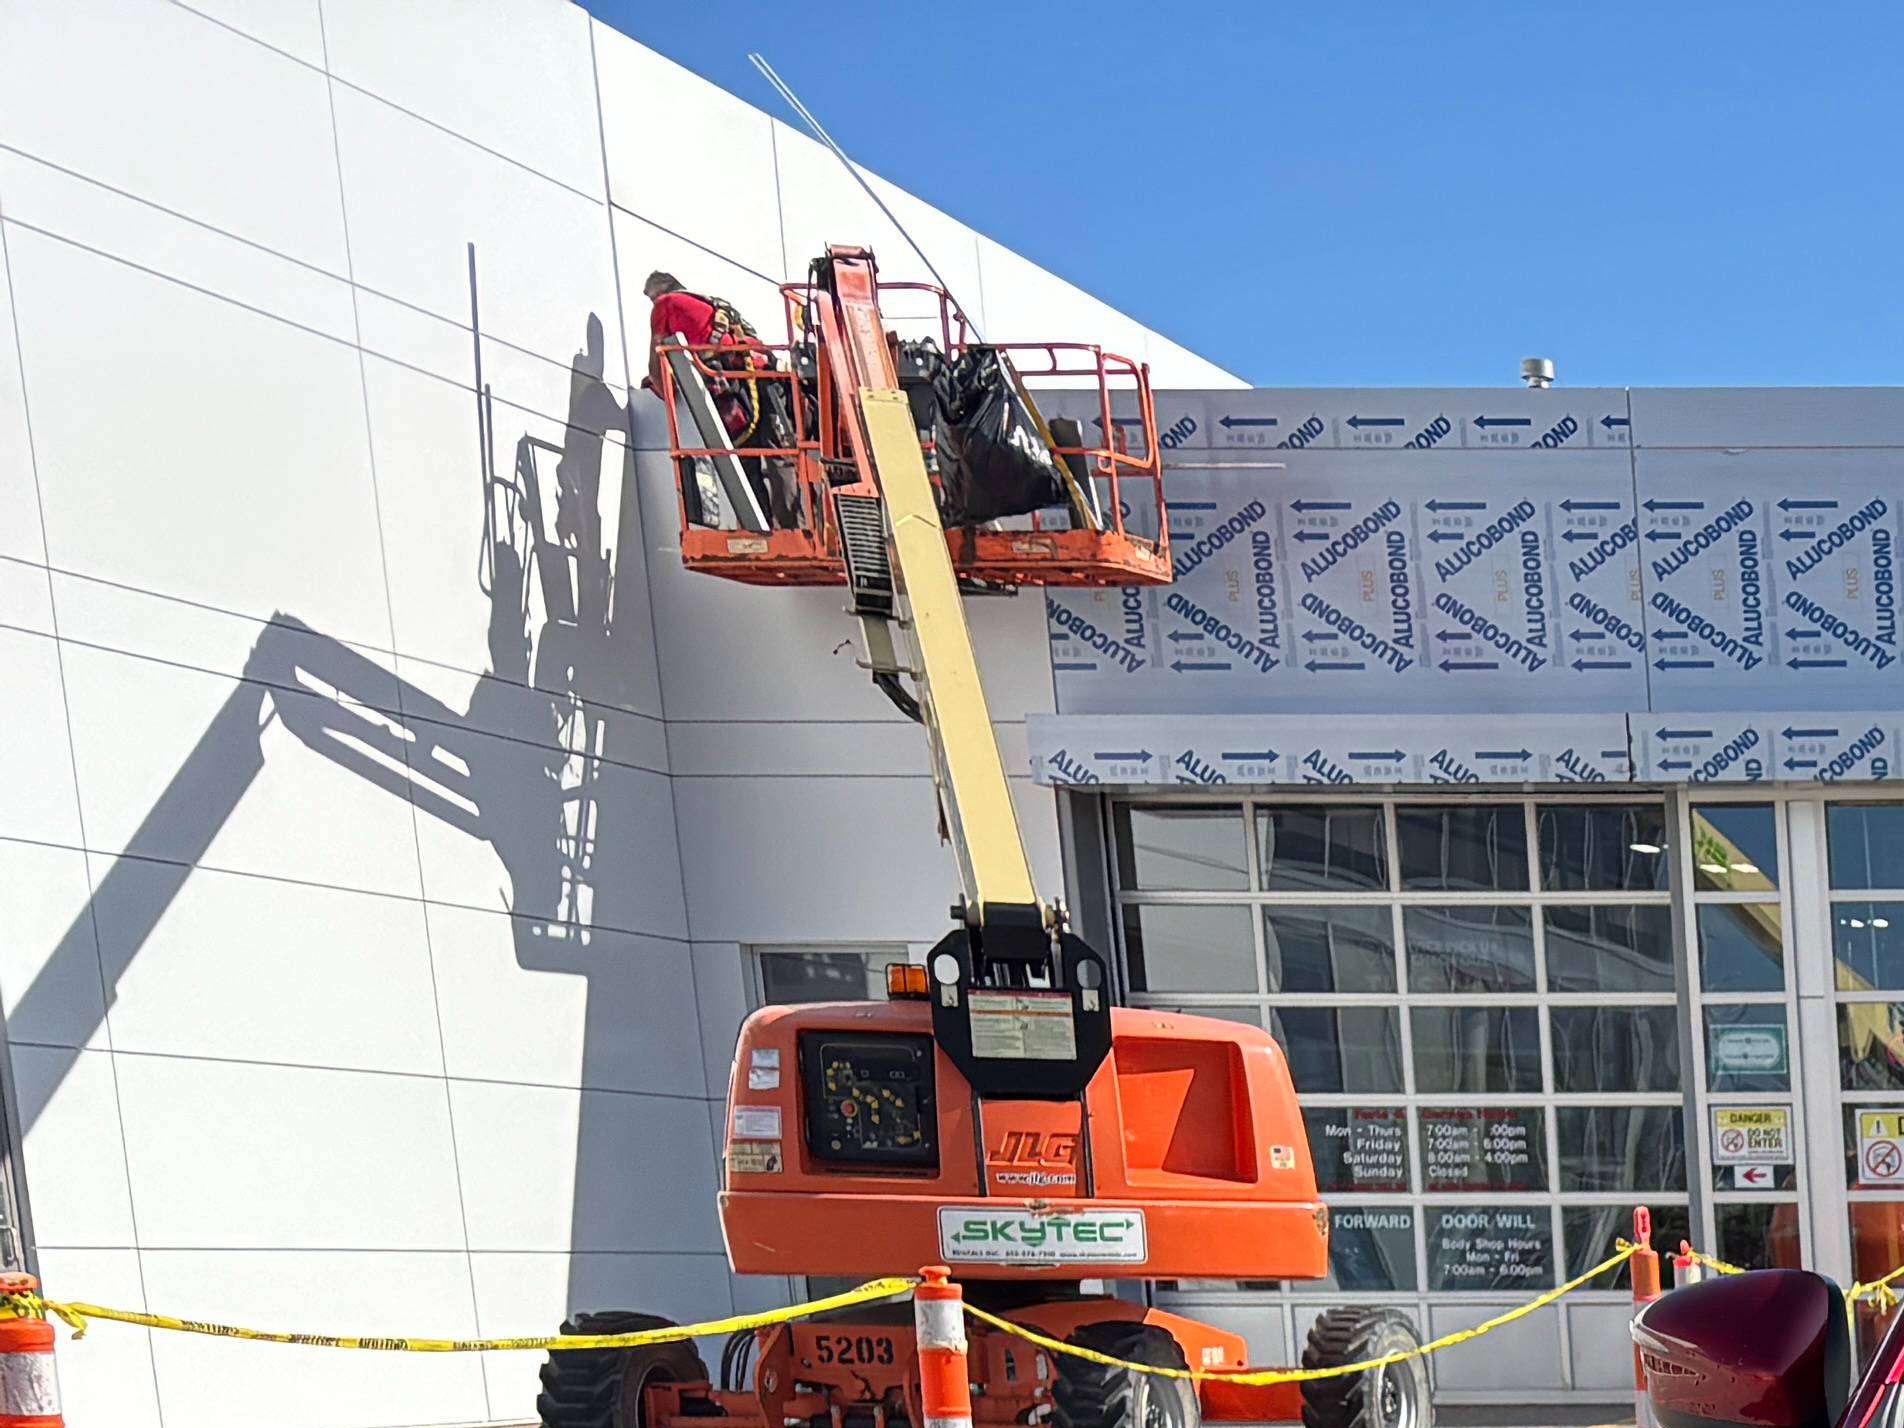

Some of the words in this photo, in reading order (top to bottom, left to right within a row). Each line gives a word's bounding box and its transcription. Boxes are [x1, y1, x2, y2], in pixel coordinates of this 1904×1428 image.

[1171, 501, 1266, 581] ALUCOBOND
[1300, 501, 1400, 582] ALUCOBOND
[1434, 501, 1536, 582] ALUCOBOND
[1651, 500, 1754, 581] ALUCOBOND
[1785, 499, 1888, 580] ALUCOBOND
[1252, 530, 1280, 648] ALUCOBOND
[1386, 530, 1414, 648] ALUCOBOND
[1521, 530, 1548, 648] ALUCOBOND
[1738, 529, 1763, 647] ALUCOBOND
[1872, 528, 1896, 646] ALUCOBOND
[1167, 593, 1280, 674] ALUCOBOND
[1300, 593, 1413, 673] ALUCOBOND
[1434, 593, 1547, 672] ALUCOBOND
[1651, 592, 1763, 671] ALUCOBOND
[1785, 591, 1896, 669] ALUCOBOND
[987, 1131, 1082, 1166] JLG
[1325, 1124, 1351, 1137] Mon
[1368, 1124, 1402, 1137] Thurs
[1356, 1138, 1401, 1151] Friday
[1730, 1113, 1772, 1124] DANGER
[1747, 1127, 1761, 1138] DO
[1747, 1138, 1783, 1148] ENTER
[1343, 1152, 1403, 1165] Saturday
[1354, 1166, 1403, 1179] Sunday
[1428, 1166, 1468, 1178] Closed
[961, 1217, 1125, 1248] SKYTEC
[1334, 1214, 1411, 1230] FORWARD
[1441, 1214, 1489, 1230] DOOR
[1496, 1214, 1537, 1230] WILL
[1442, 1237, 1471, 1250] Body
[1475, 1237, 1504, 1250] Shop
[1508, 1237, 1541, 1250] Hours
[1466, 1251, 1490, 1262] Mon
[1504, 1251, 1519, 1262] Fri
[815, 1335, 895, 1366] 5203
